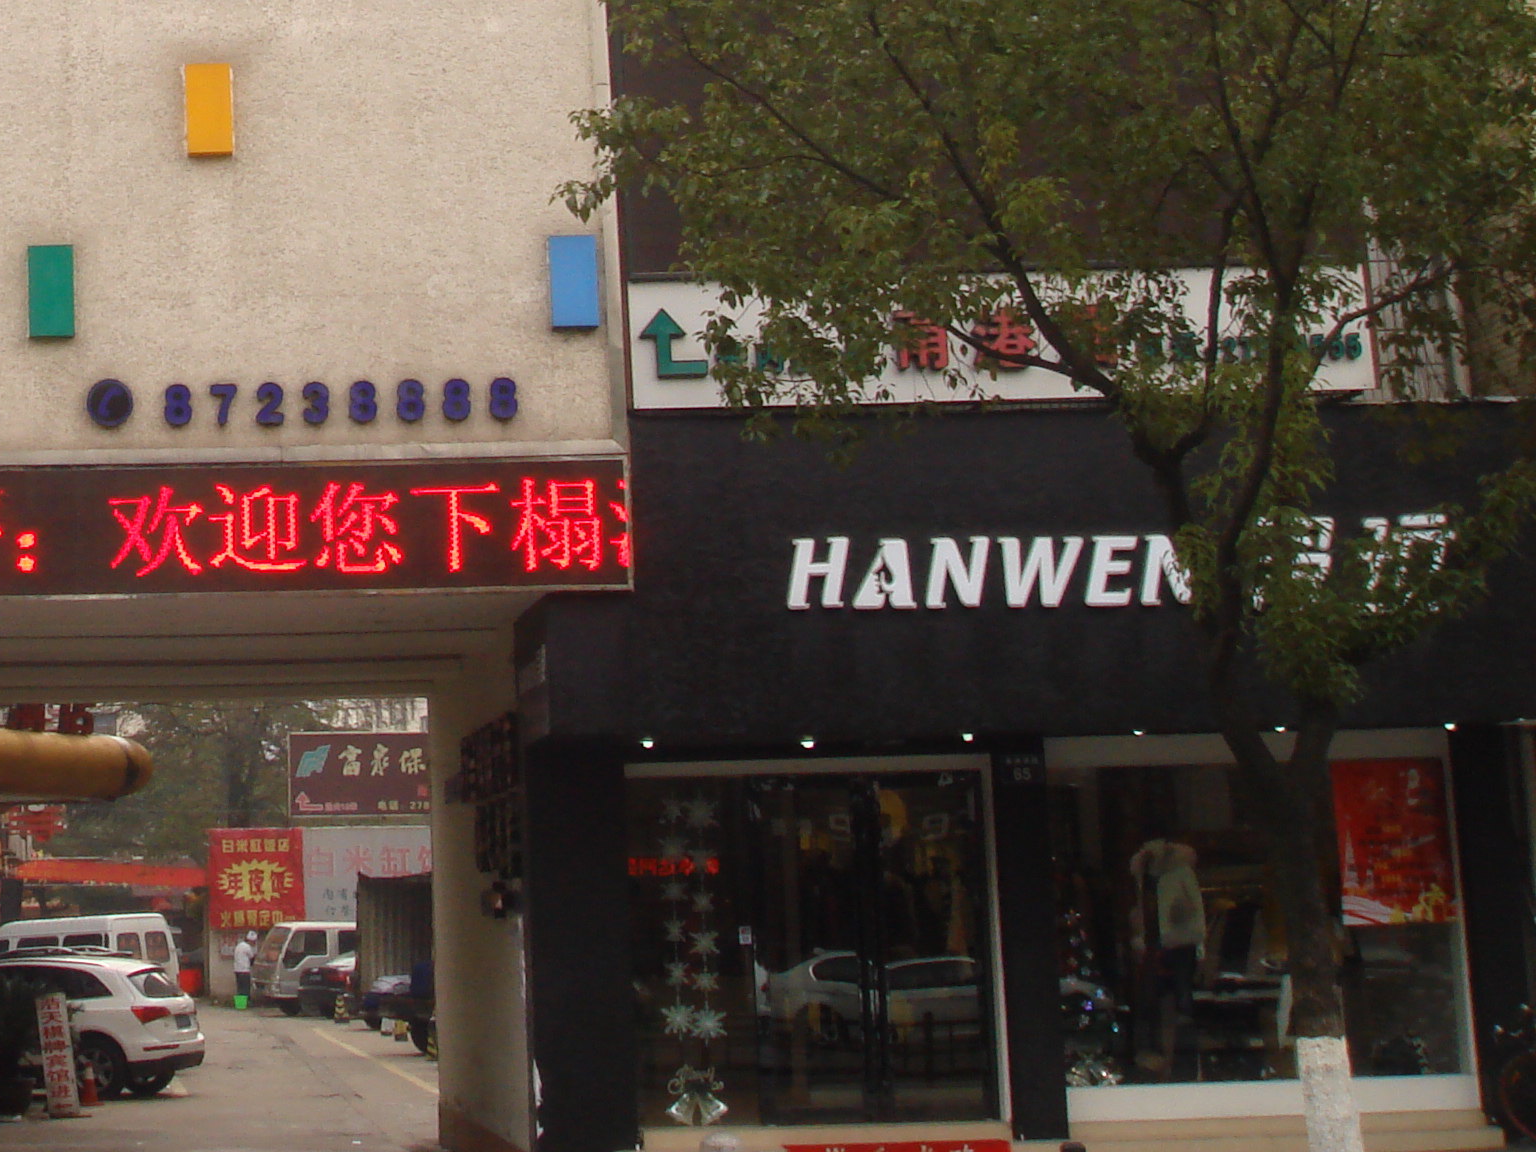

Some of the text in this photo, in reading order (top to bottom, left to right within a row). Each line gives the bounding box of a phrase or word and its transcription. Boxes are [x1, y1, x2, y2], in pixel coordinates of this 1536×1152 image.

[162, 376, 520, 428] 87238888
[786, 534, 1193, 610] HANWEN
[1012, 766, 1033, 781] 65
